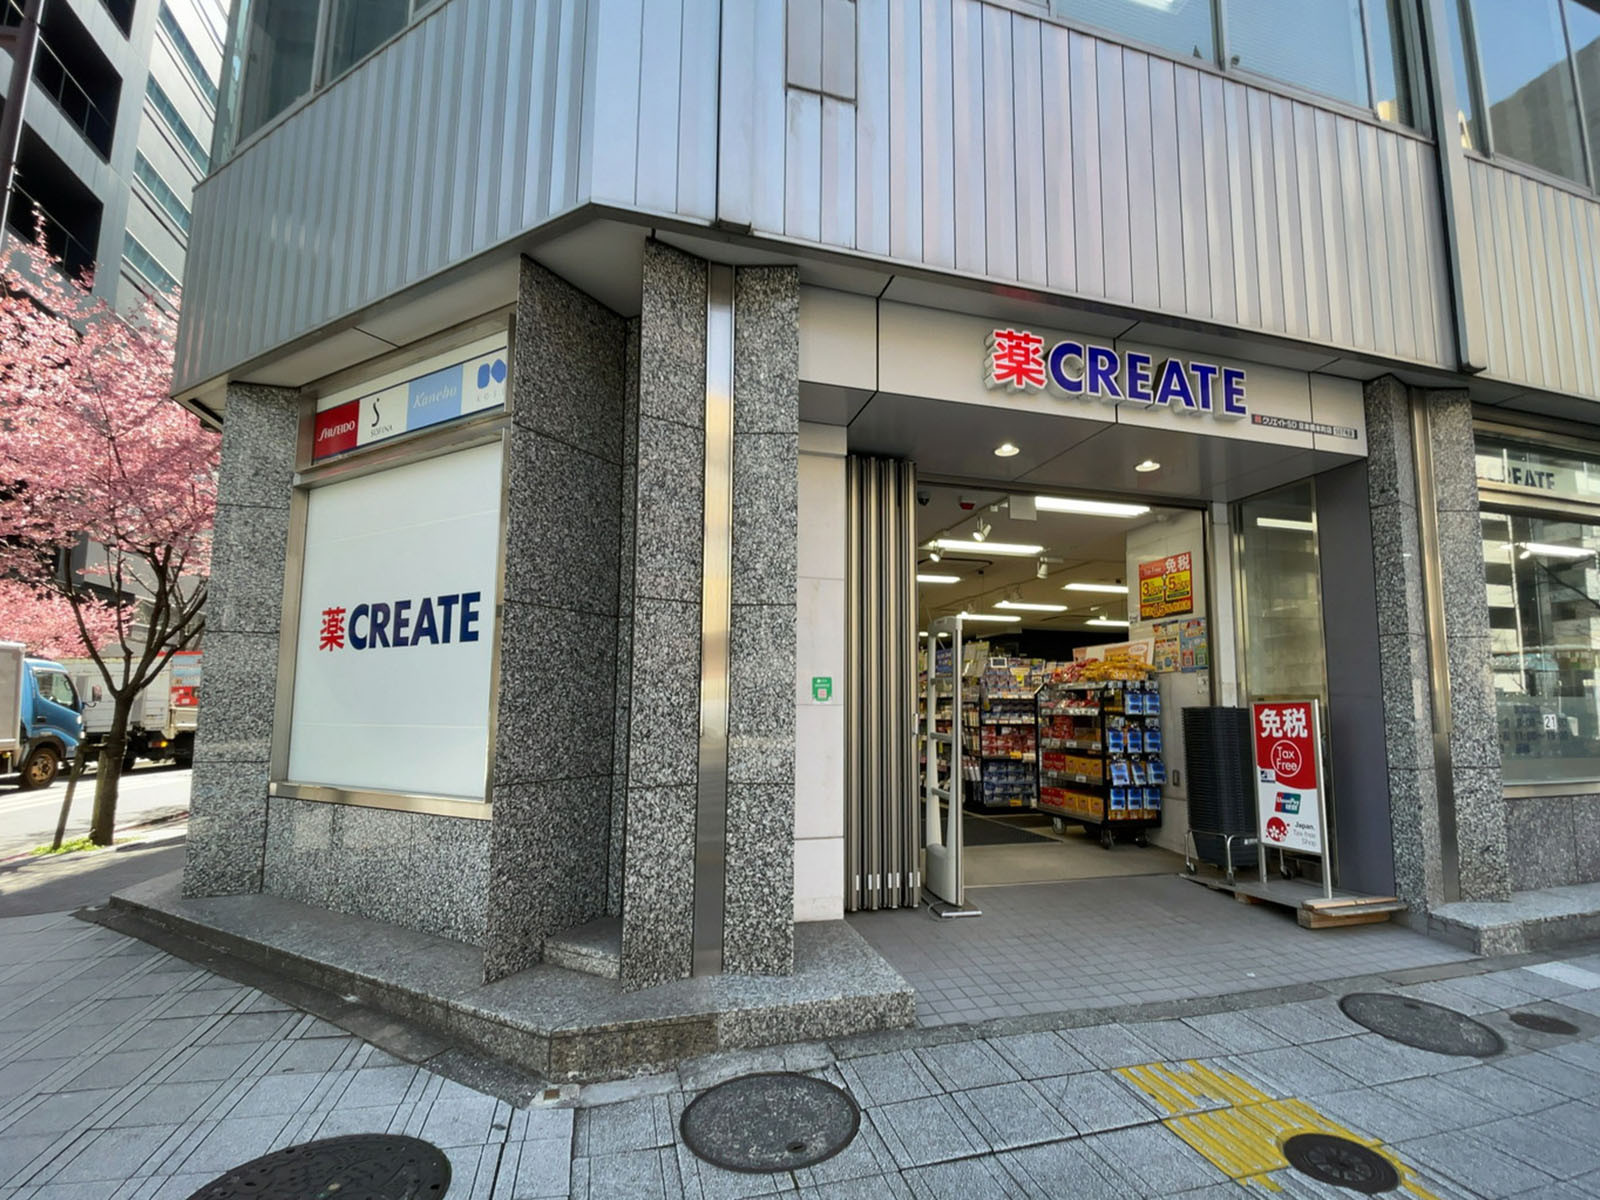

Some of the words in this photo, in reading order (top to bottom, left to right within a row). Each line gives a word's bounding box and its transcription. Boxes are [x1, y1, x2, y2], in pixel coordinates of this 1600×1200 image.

[413, 385, 457, 408] Kanebo
[317, 420, 356, 442] SHISEIDO
[370, 424, 393, 438] SOFINA
[1165, 554, 1190, 574] 免税
[1259, 708, 1308, 738] 免税
[1276, 746, 1295, 759] Tax
[1276, 758, 1297, 771] Free
